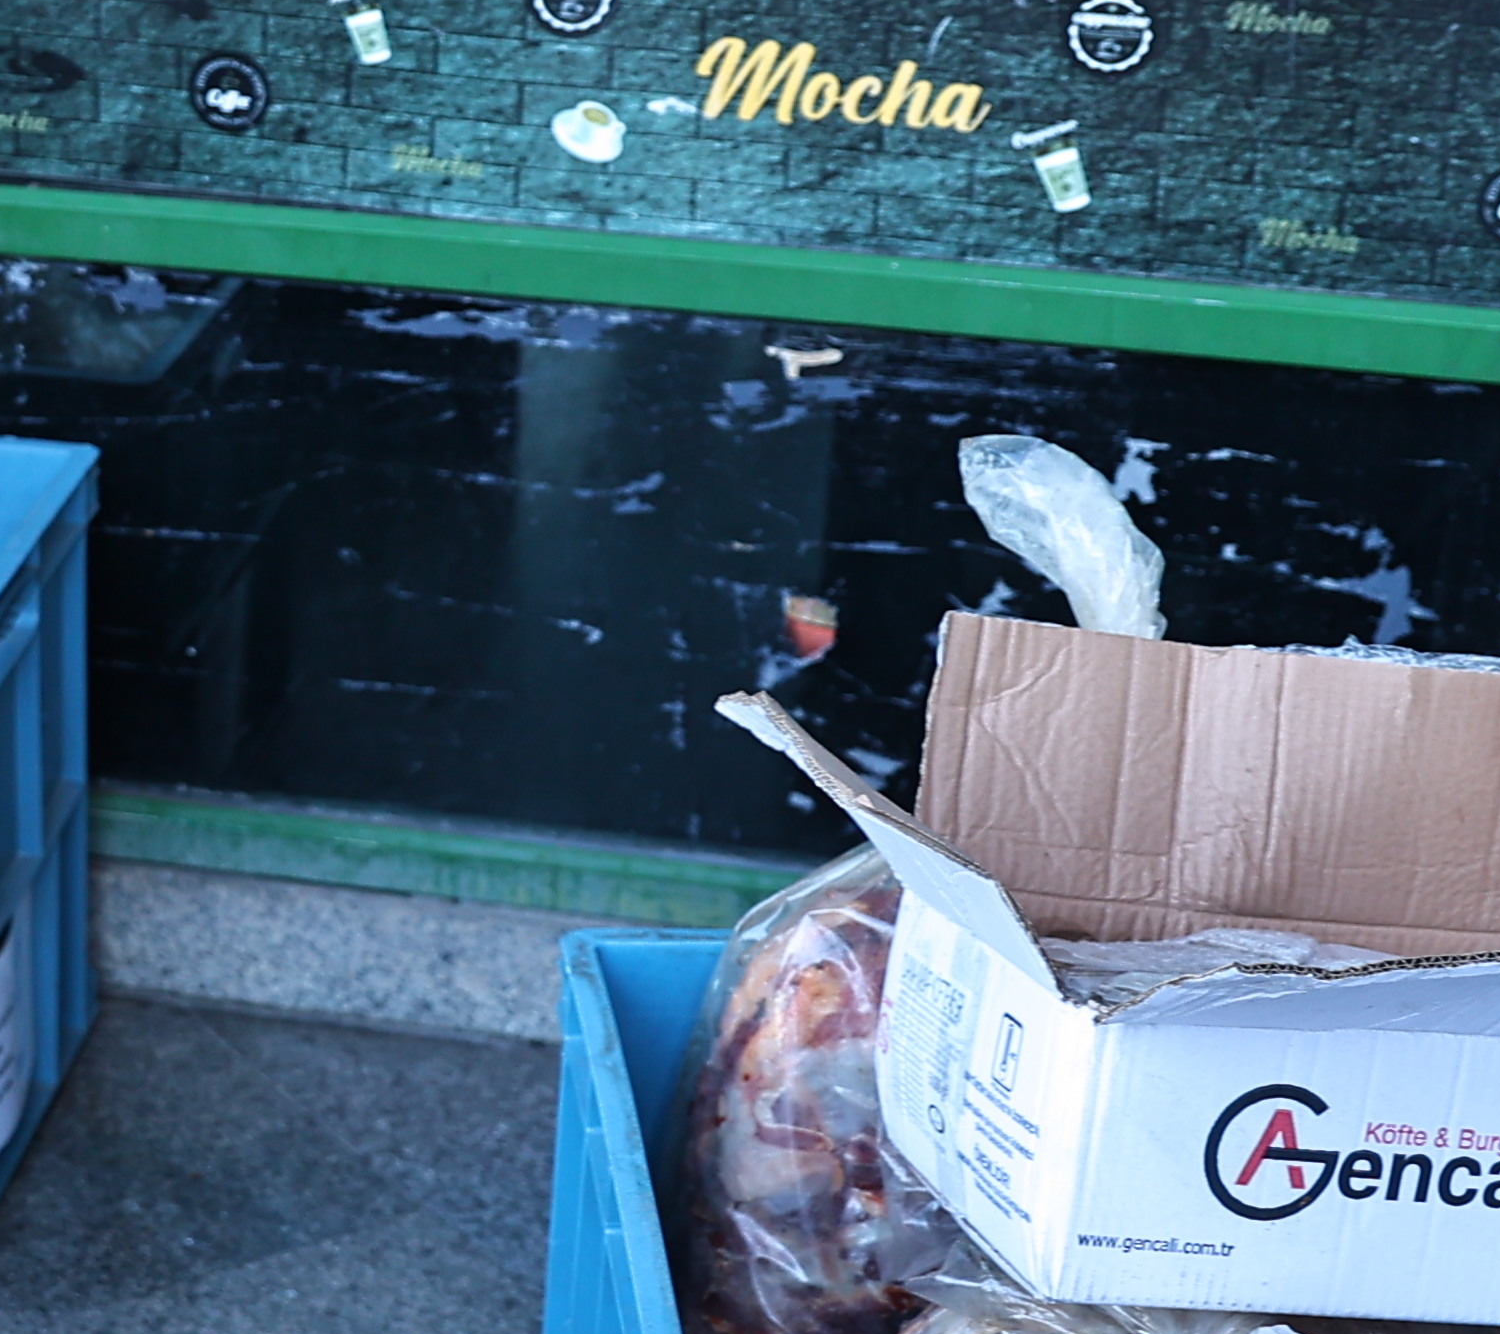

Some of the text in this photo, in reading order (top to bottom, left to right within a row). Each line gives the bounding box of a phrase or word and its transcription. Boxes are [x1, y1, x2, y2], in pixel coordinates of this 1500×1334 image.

[694, 35, 994, 134] Mocha
[1364, 1121, 1429, 1148] Köfte
[1434, 1127, 1450, 1149] &
[1077, 1234, 1236, 1258] www.gencali.com.tr
